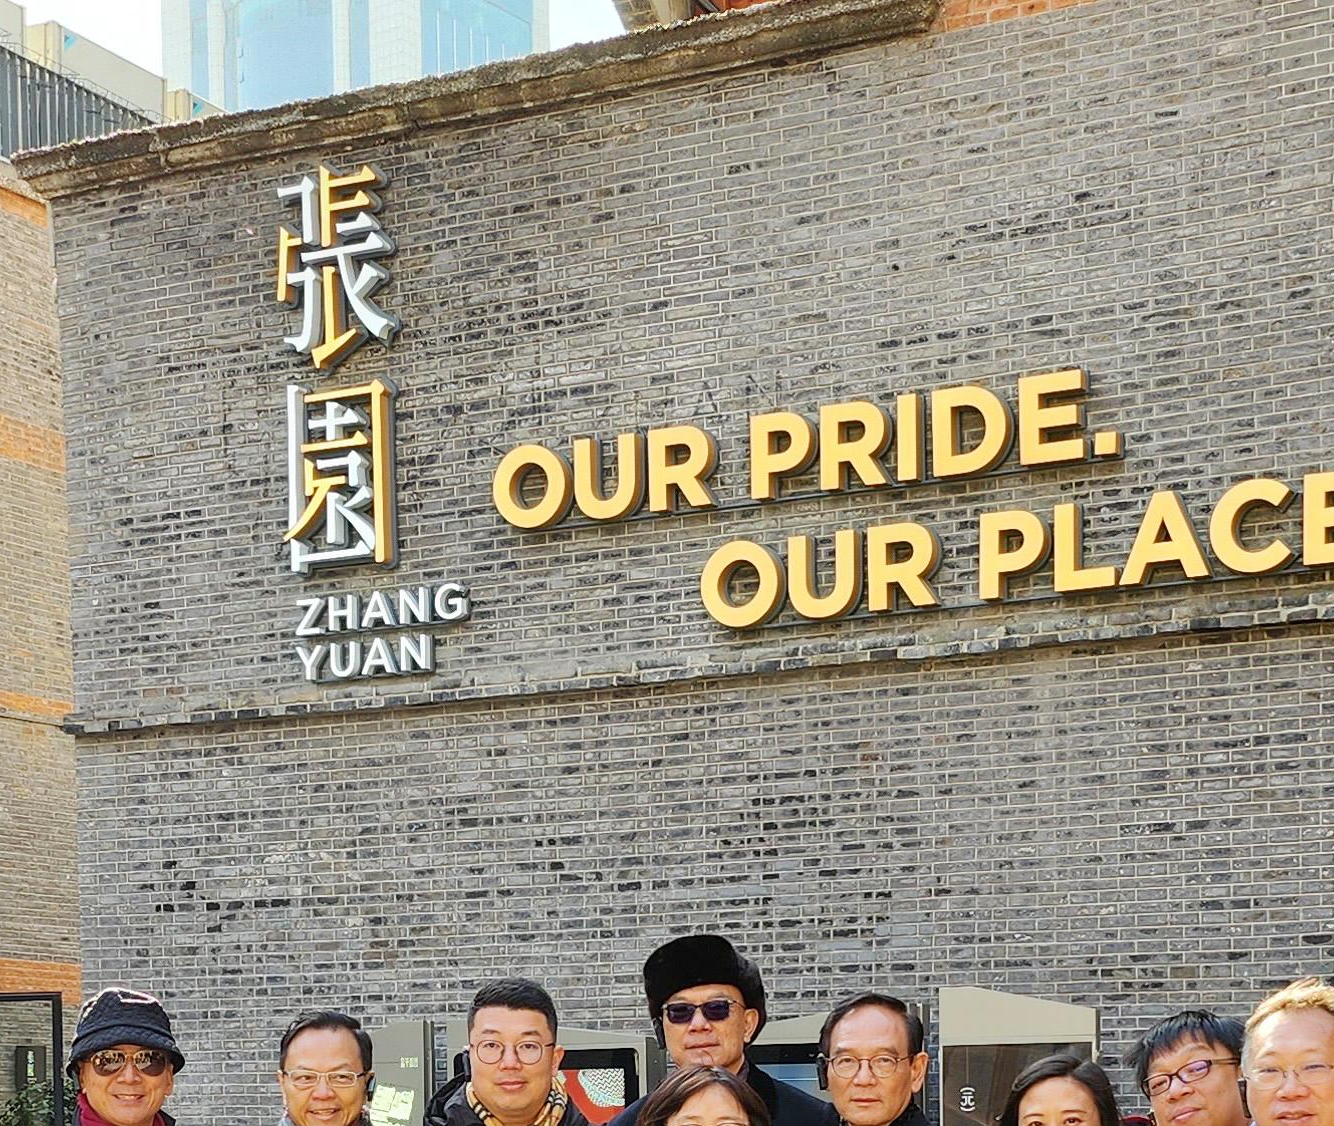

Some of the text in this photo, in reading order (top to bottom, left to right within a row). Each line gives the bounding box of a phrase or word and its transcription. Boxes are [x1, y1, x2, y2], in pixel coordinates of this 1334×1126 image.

[275, 162, 399, 575] 張園
[492, 367, 1123, 529] OUR PRIDE.
[295, 582, 470, 638] ZHANG
[700, 521, 941, 631] OUR
[295, 633, 435, 684] YUAN
